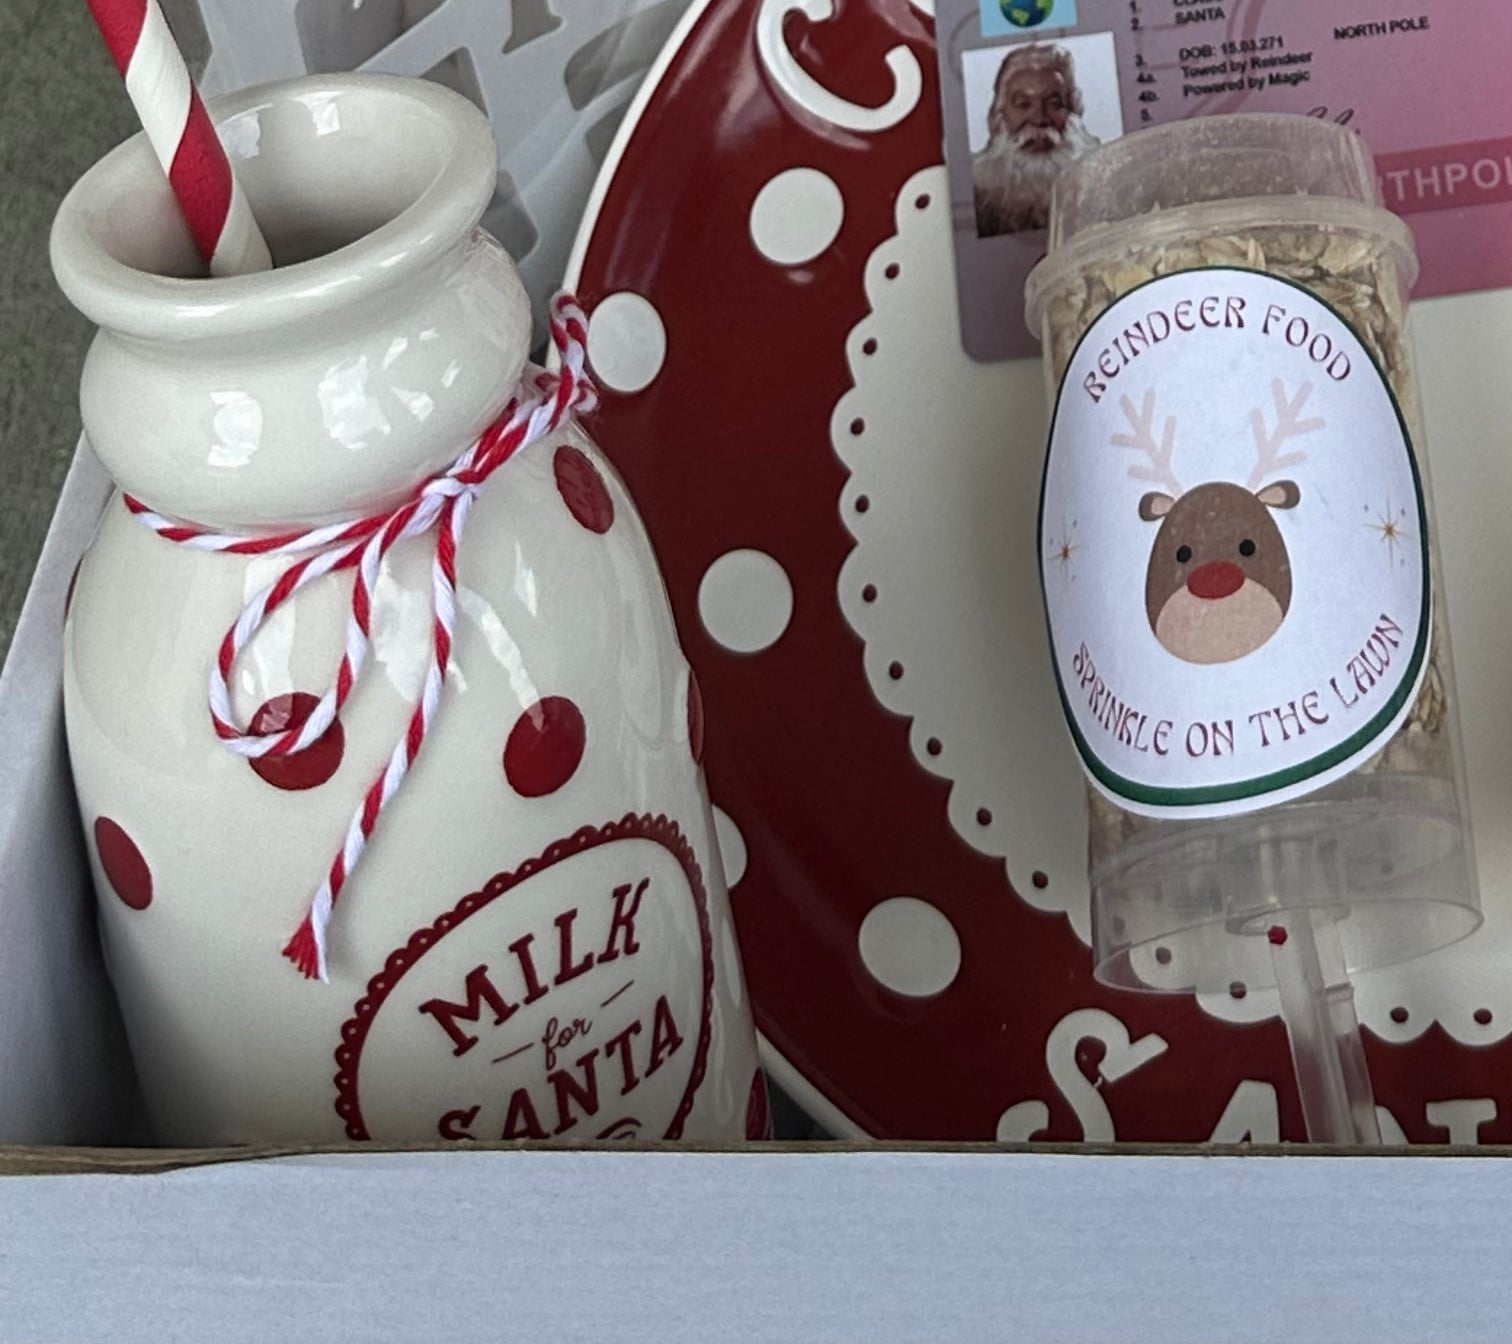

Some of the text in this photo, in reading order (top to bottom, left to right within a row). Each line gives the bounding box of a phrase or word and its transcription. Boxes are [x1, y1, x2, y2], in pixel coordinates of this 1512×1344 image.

[1175, 7, 1226, 25] SANTA
[1179, 44, 1216, 62] DOB:
[1333, 21, 1387, 40] NORTH
[1390, 15, 1430, 34] POLE
[1181, 62, 1227, 79] Towed
[1229, 59, 1247, 74] by
[1250, 51, 1313, 70] Reindeer
[1183, 78, 1244, 97] Powered
[1247, 76, 1265, 91] by
[1268, 69, 1311, 87] Magic
[1082, 294, 1352, 403] REINDEER FOOD
[1071, 613, 1404, 758] SPRINKLE ON THE LAWN
[418, 877, 651, 1057] MILK
[541, 1017, 593, 1071] for
